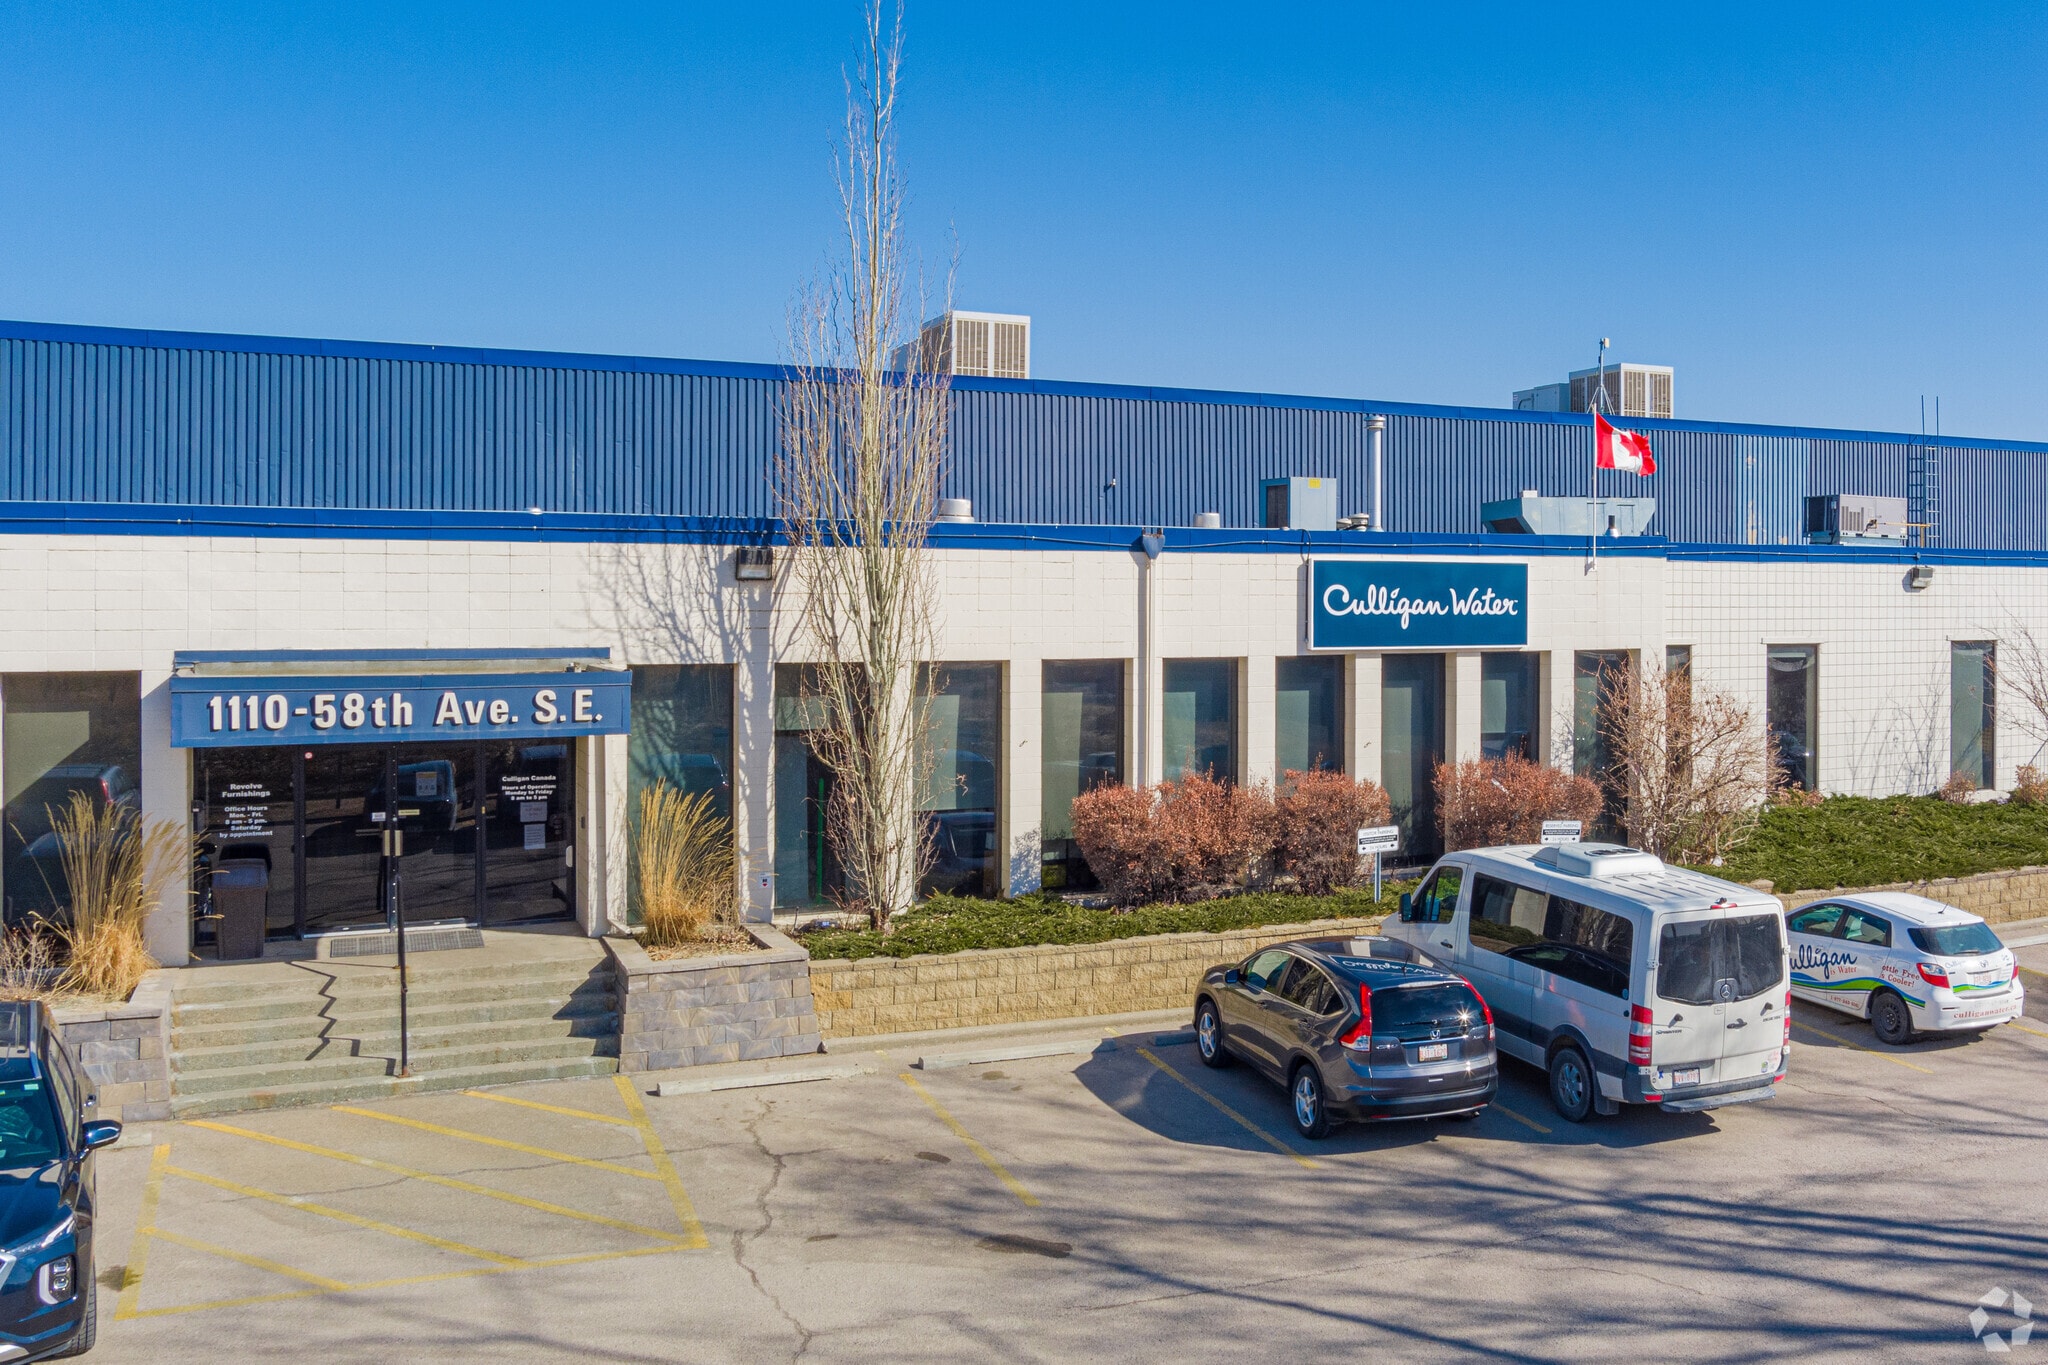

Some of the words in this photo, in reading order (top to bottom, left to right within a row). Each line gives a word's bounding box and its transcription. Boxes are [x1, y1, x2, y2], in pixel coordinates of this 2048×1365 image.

[1323, 583, 1449, 630] Culligan
[1449, 587, 1518, 616] Water
[209, 692, 413, 731] 1110-58th
[436, 691, 519, 726] Ave.
[532, 689, 604, 724] S.E.
[222, 790, 271, 798] Furnishings
[229, 830, 273, 838] appointment
[1790, 944, 1858, 979] ulligan
[1830, 967, 1836, 975] is
[1838, 965, 1857, 974] Water
[1902, 969, 1920, 980] Free
[1888, 974, 1915, 987] Cooler!
[1954, 1004, 2017, 1018] culliganwater.ca
